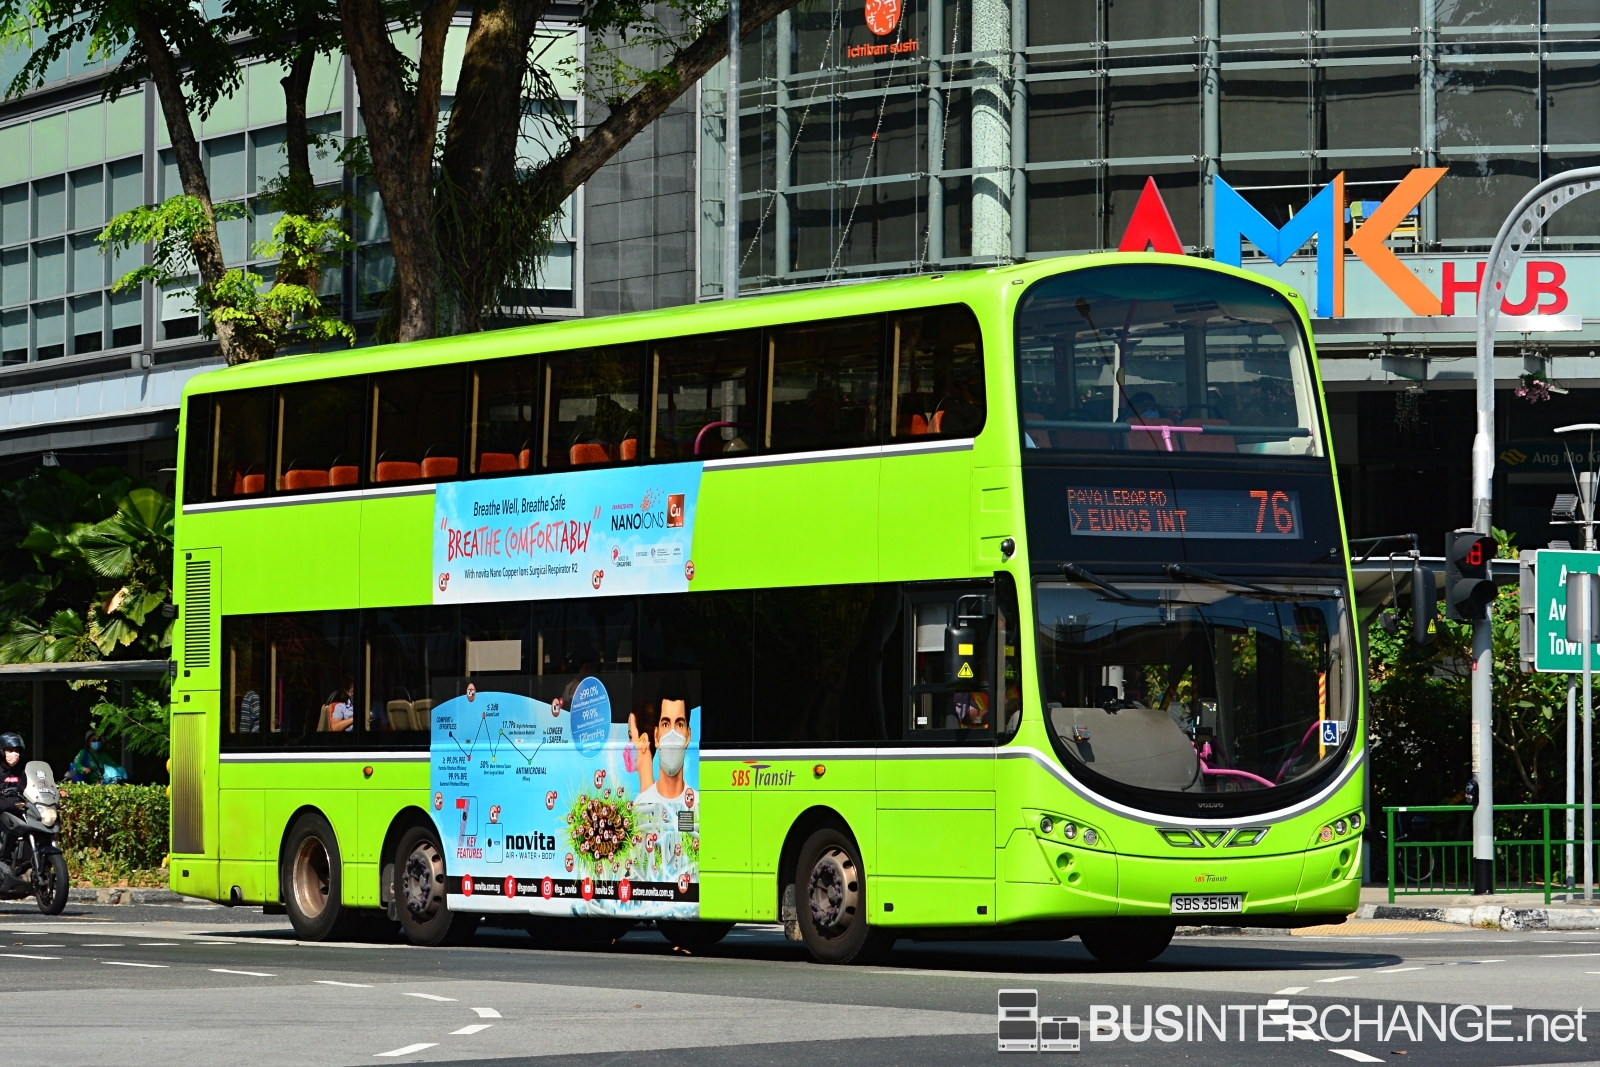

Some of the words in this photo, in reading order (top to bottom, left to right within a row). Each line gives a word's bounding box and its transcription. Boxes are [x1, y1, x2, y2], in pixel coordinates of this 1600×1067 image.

[847, 43, 887, 58] ichiban
[890, 38, 919, 54] sushi
[1118, 168, 1449, 318] AMK
[1442, 261, 1568, 316] HUB
[1532, 452, 1558, 466] Ang
[1563, 452, 1583, 462] Mo
[474, 500, 500, 516] Breathe
[502, 498, 520, 516] Well,
[522, 496, 549, 513] Breathe
[550, 494, 566, 511] Safe
[1150, 491, 1167, 506] RD
[670, 504, 681, 518] Cu
[1250, 490, 1293, 534] 76
[1088, 508, 1152, 532] EUNOS
[1156, 510, 1187, 532] INT
[464, 568, 475, 579] With
[476, 568, 490, 578] novita
[490, 568, 502, 578] Nano
[502, 567, 518, 580] Copper
[530, 565, 547, 578] Surgical
[548, 564, 571, 577] Respirator
[572, 563, 578, 574] R2
[1548, 598, 1566, 620] Av
[582, 708, 598, 720] 99.9%
[579, 729, 604, 743] 120mmHg
[732, 770, 750, 786] SBS
[750, 765, 796, 789] Transit
[466, 837, 477, 847] KEY
[506, 831, 556, 850] novita
[456, 848, 482, 859] FEATURES
[1205, 874, 1227, 882] Transit
[474, 882, 500, 893] novita.com.sg
[595, 886, 607, 895] novita
[608, 886, 614, 895] SG
[632, 887, 674, 899] estore.novita.com.sg
